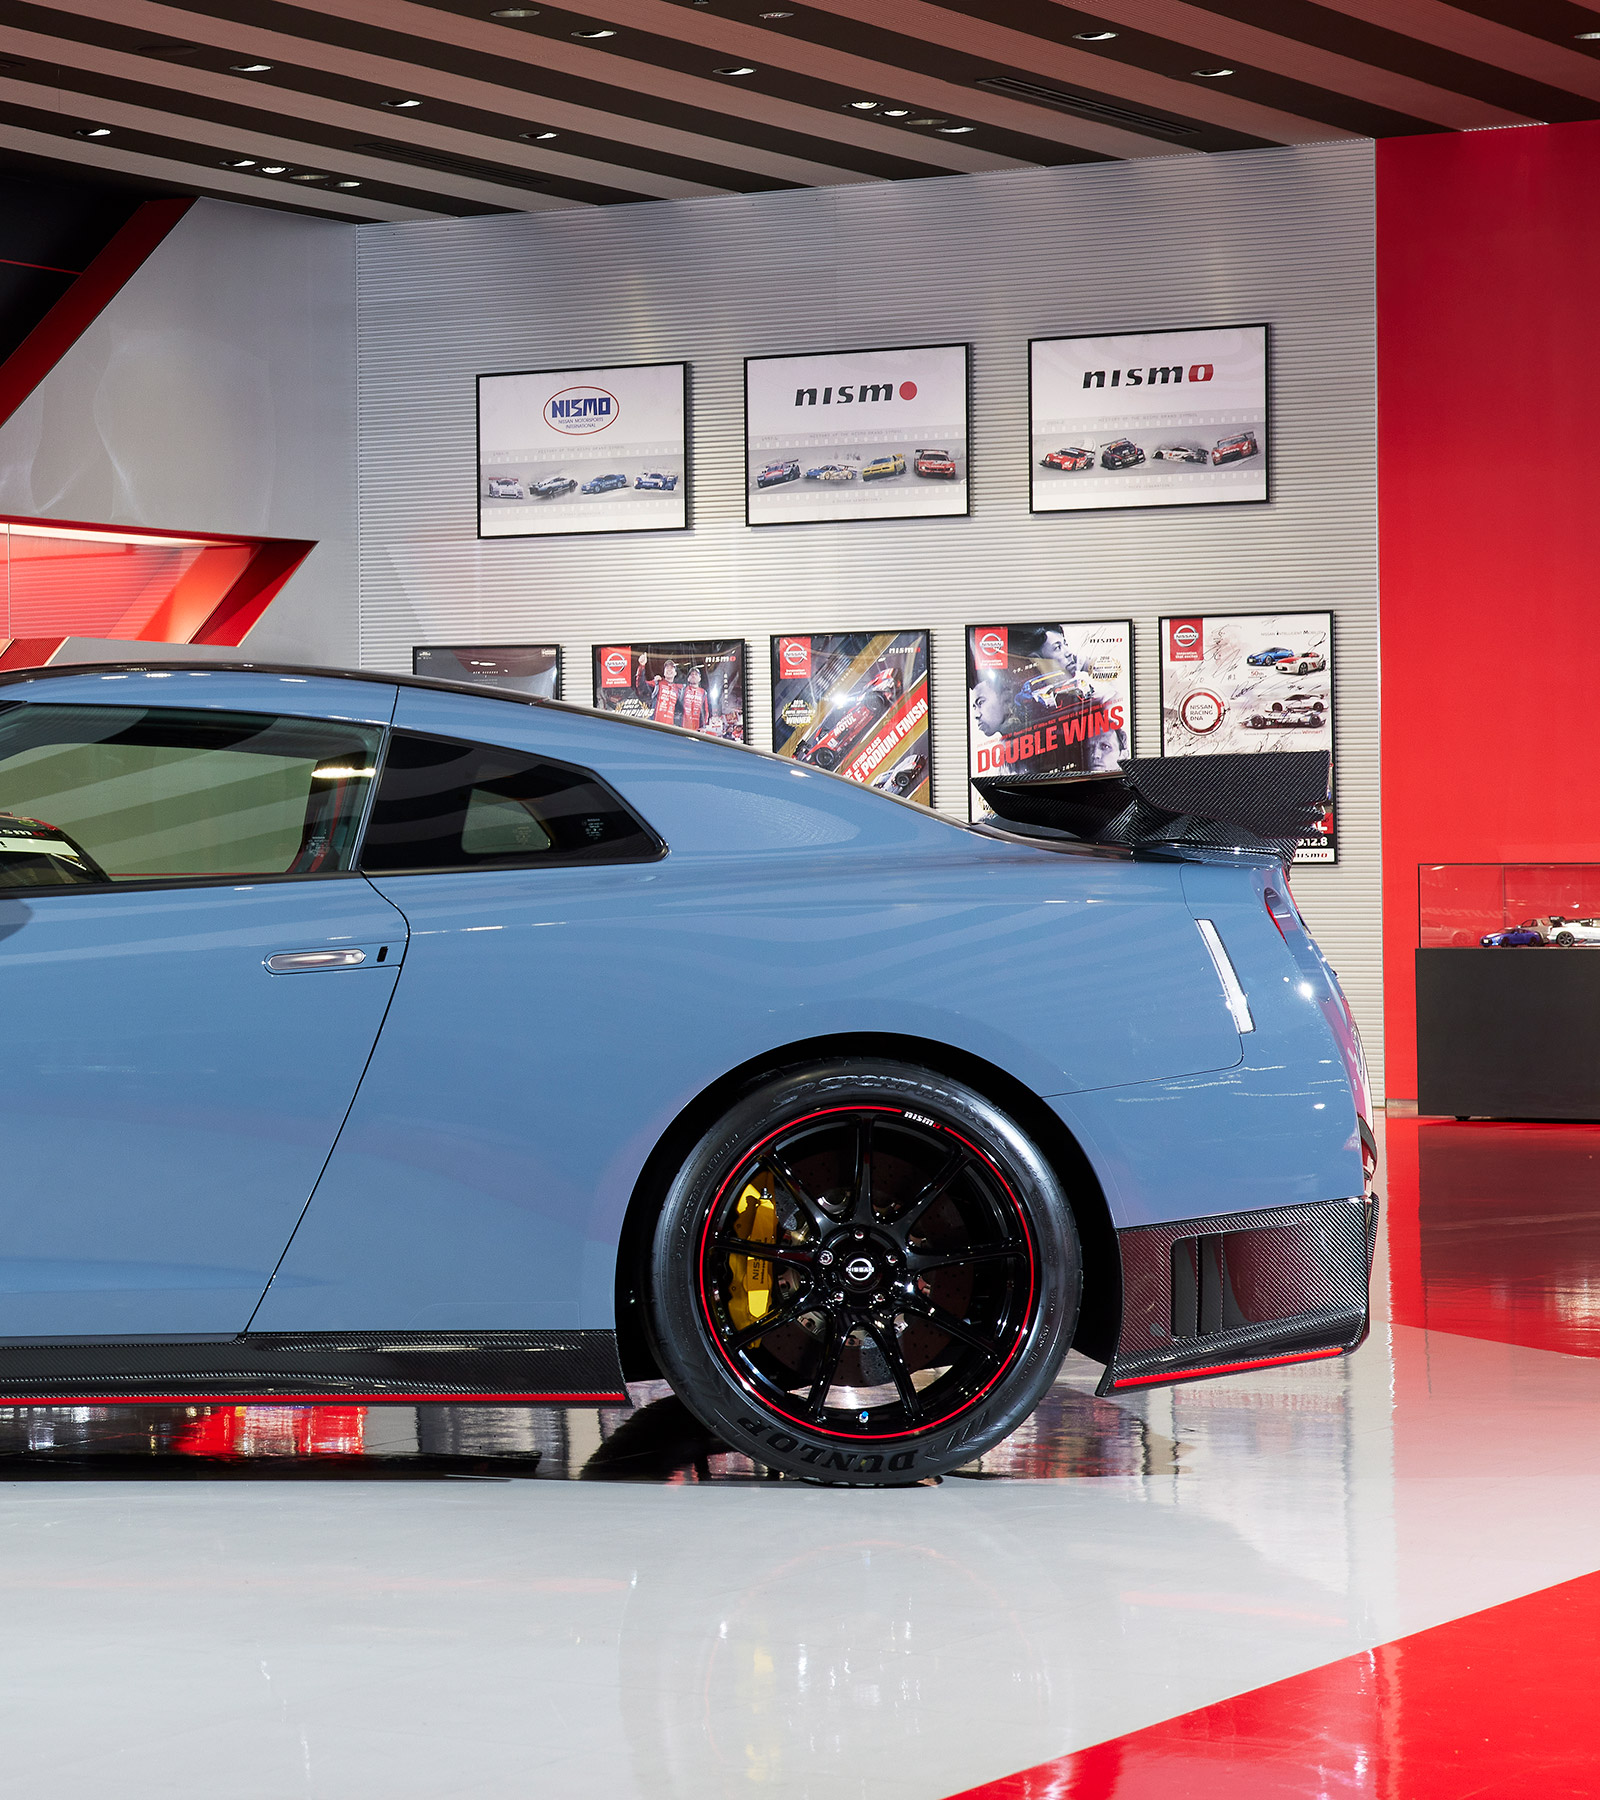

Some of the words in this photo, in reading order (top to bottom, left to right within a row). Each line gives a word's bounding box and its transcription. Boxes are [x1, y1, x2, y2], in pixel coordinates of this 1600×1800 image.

[1083, 364, 1213, 389] nismo
[552, 397, 611, 418] NISMO
[612, 709, 654, 717] AMPIONS
[834, 716, 857, 736] MOTUL
[861, 731, 900, 776] PODIUM
[896, 698, 929, 738] FINISH
[977, 725, 1058, 774] DOUBLE
[1063, 705, 1124, 746] WINS
[1298, 837, 1328, 846] 9.12.8
[904, 1111, 941, 1129] nismo
[737, 1417, 919, 1473] DUNLOP
